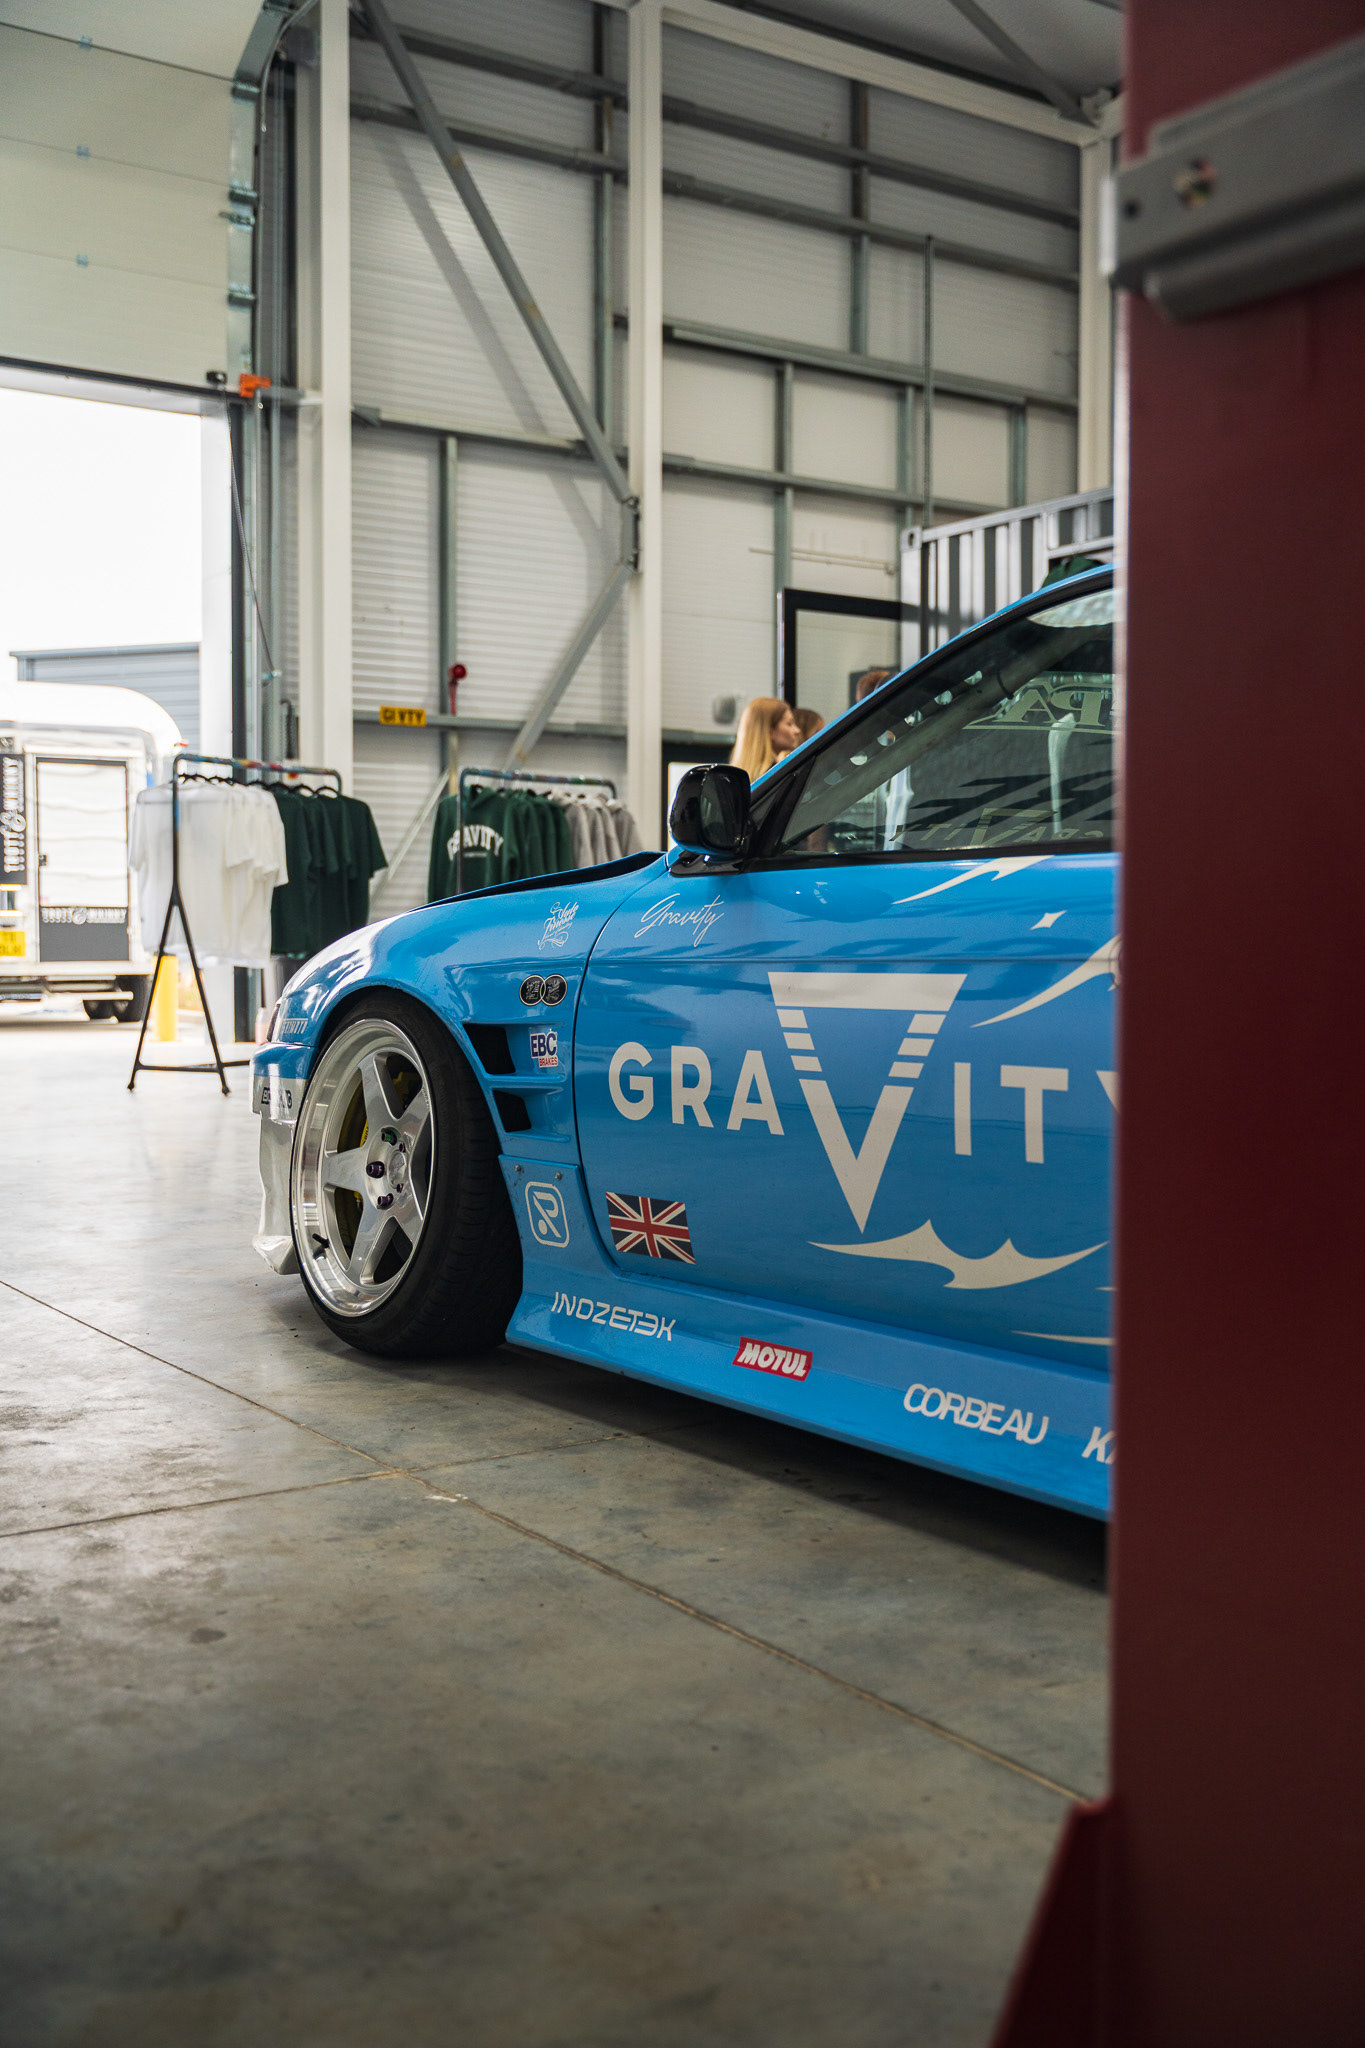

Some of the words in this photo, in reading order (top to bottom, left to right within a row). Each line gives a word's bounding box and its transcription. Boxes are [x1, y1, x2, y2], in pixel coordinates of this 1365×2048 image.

[634, 893, 724, 947] Gravity
[530, 1032, 557, 1058] EBC
[539, 1056, 558, 1067] BRAKES
[737, 1342, 808, 1377] MOTUL
[903, 1383, 1049, 1444] CORBEAU
